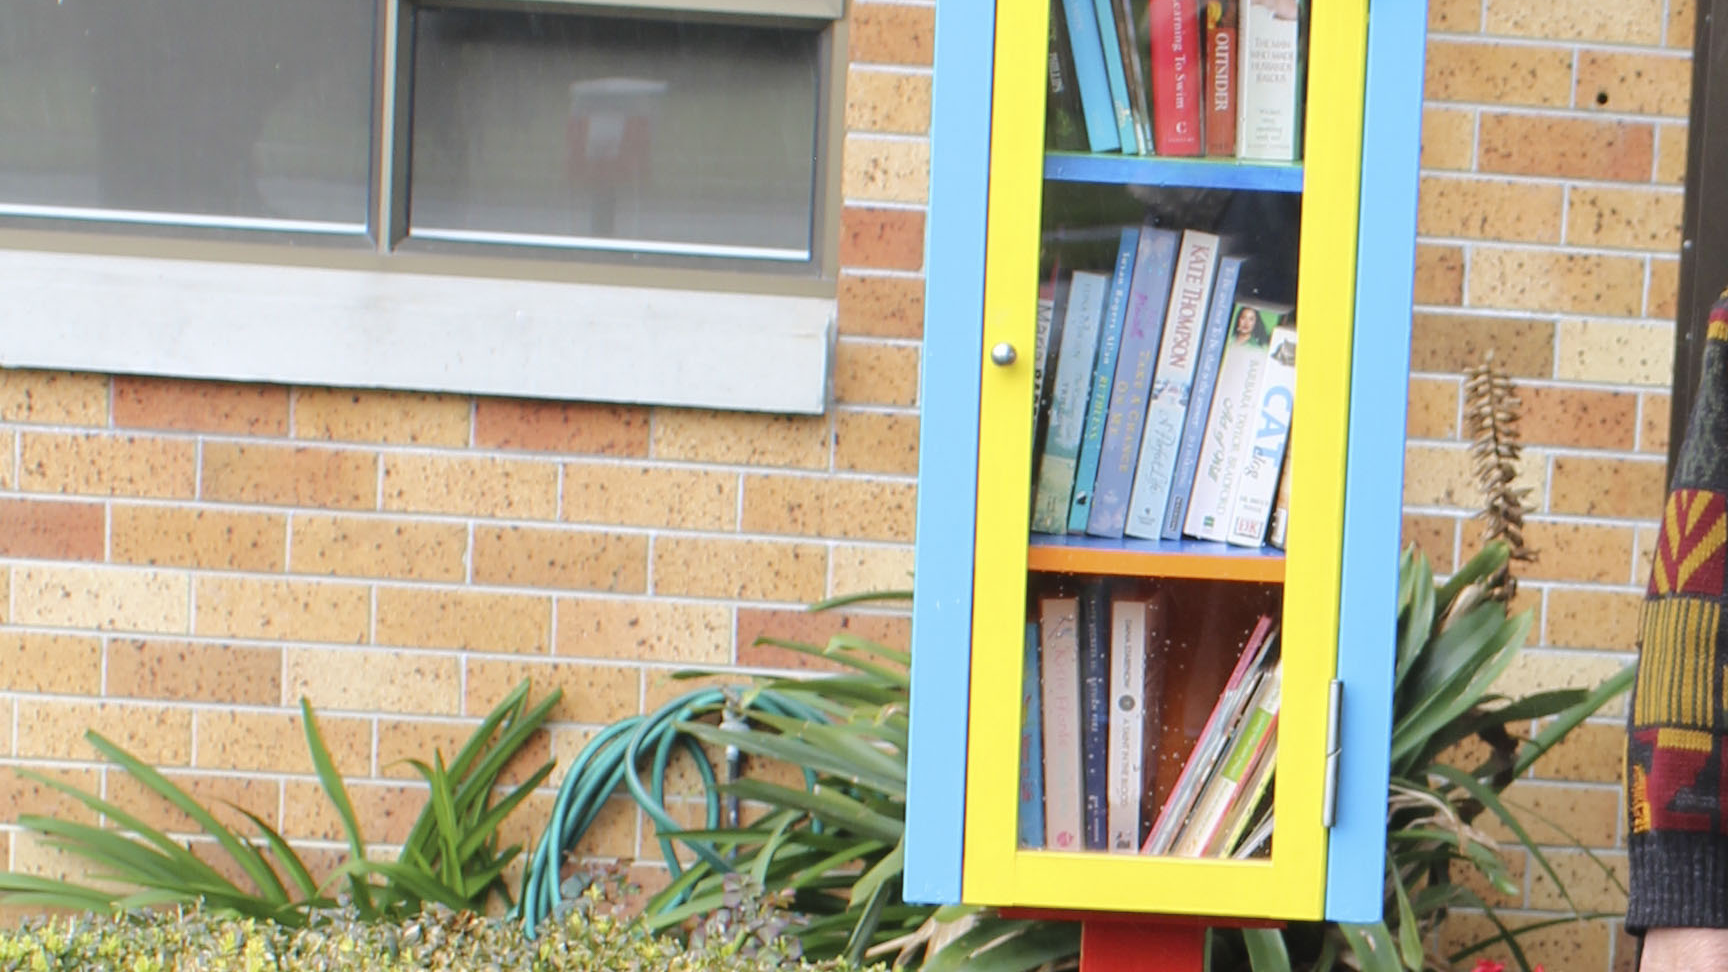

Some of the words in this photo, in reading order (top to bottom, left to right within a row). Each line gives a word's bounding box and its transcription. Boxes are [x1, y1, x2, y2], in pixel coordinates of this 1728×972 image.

[1174, 54, 1187, 71] To
[1214, 32, 1230, 111] OUTSIDER
[1175, 72, 1187, 110] Swim
[1184, 243, 1209, 284] KATE
[1167, 285, 1203, 369] THOMPSON
[1089, 374, 1108, 440] RUTHLESS
[1237, 358, 1262, 409] BARBARA
[1227, 411, 1249, 453] TAYLOR
[1213, 455, 1239, 515] BRADFORD
